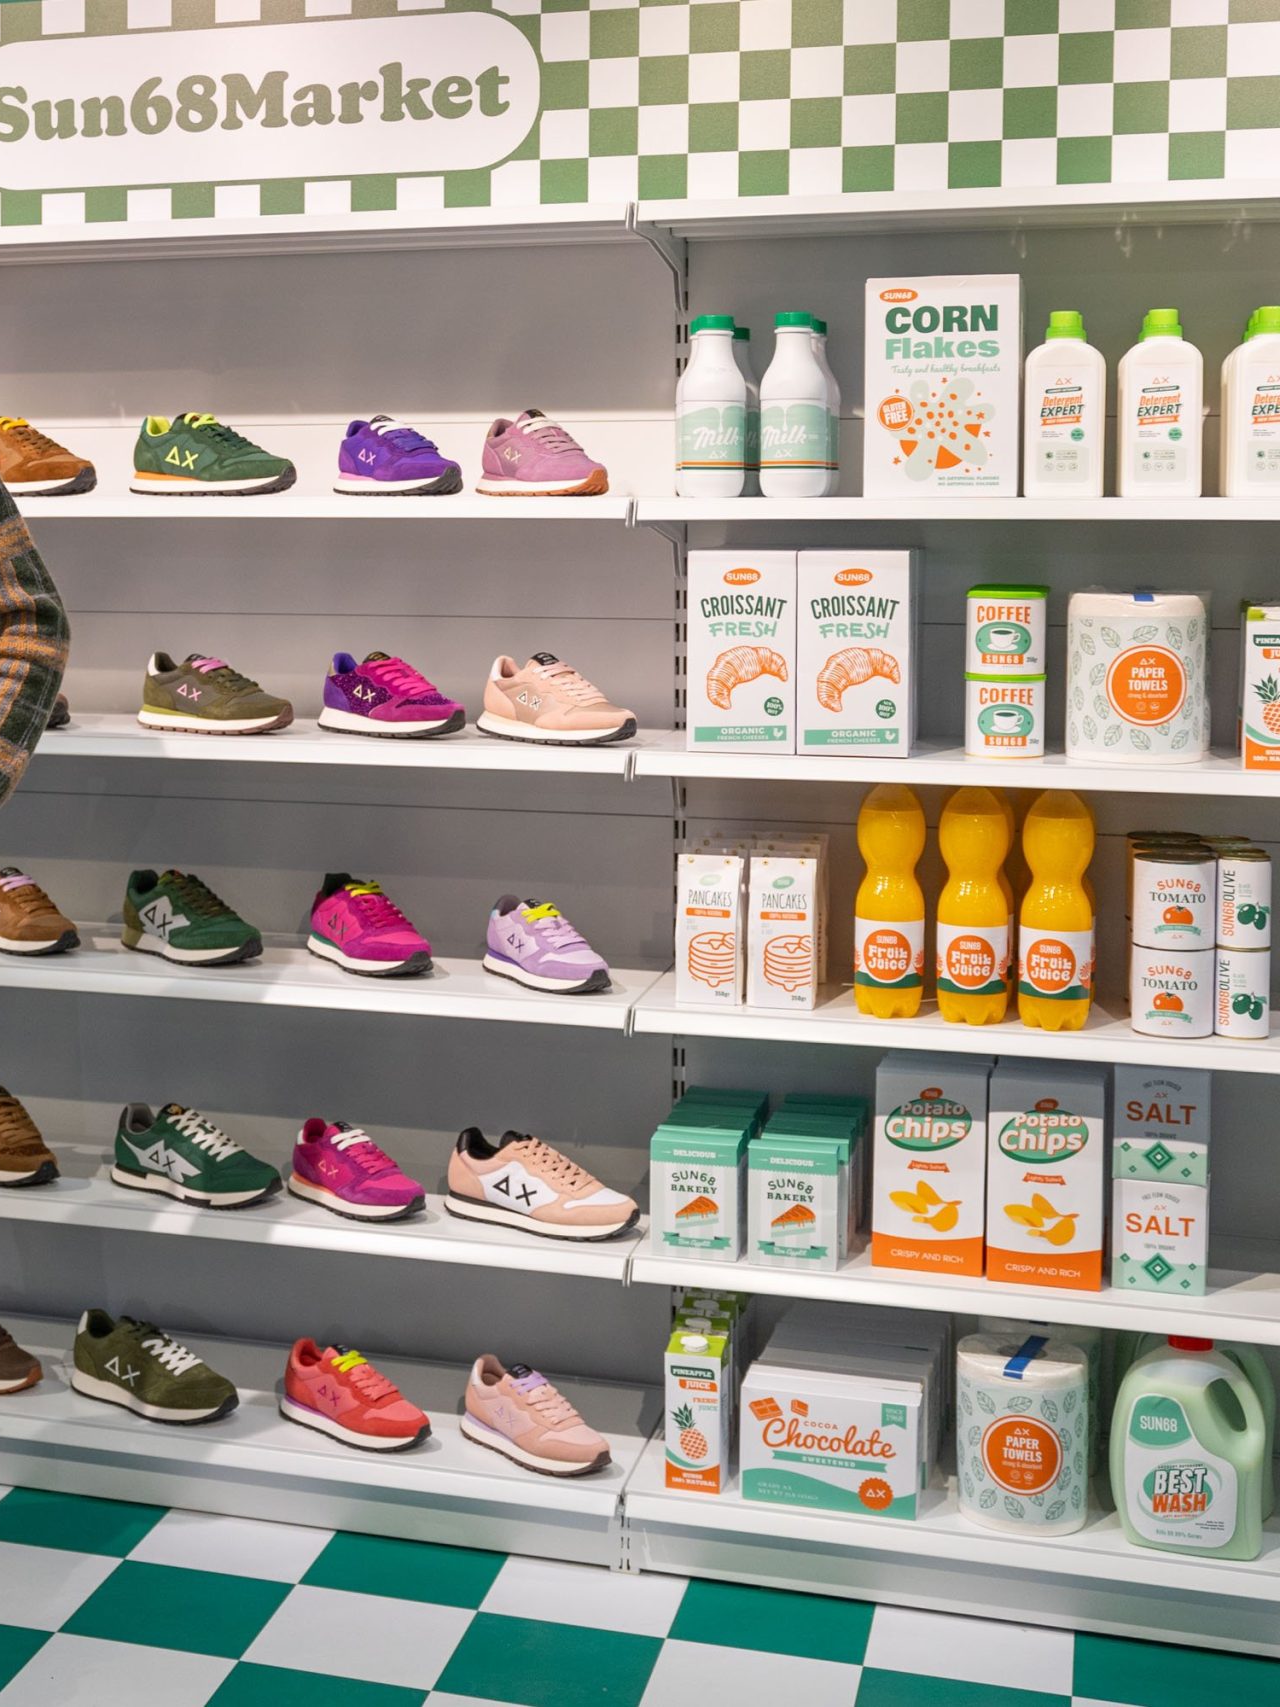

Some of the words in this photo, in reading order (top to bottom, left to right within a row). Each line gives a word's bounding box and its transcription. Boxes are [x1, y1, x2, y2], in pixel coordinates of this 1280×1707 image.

[883, 292, 912, 300] SUN68
[885, 304, 998, 334] CORN
[885, 337, 1000, 360] Flakes
[1043, 394, 1083, 407] Detergent
[1140, 393, 1181, 406] Detergent
[885, 409, 909, 425] FREE
[1041, 404, 1084, 417] EXPERT
[1137, 404, 1182, 417] EXPERT
[1252, 404, 1280, 416] EXPE
[692, 426, 739, 450] Milk
[761, 425, 807, 449] Milk
[726, 573, 758, 581] SUN68
[837, 573, 870, 582] SUN68
[700, 594, 787, 619] CROISSANT
[810, 595, 900, 620] CROISSANT
[977, 605, 1032, 625] COFFEE
[708, 620, 778, 638] FRESH
[818, 622, 890, 639] FRESH
[1255, 636, 1280, 644] PINEA
[985, 654, 1020, 664] SUN68
[1131, 667, 1165, 678] PAPER
[1128, 680, 1168, 691] TOWELS
[979, 687, 1034, 706] COFFEE
[721, 727, 765, 735] ORGANIC
[831, 730, 877, 738] ORGANIC
[989, 737, 1023, 746] SUN68
[1157, 878, 1201, 893] SUN68
[688, 889, 733, 908] PANCAKES
[761, 892, 807, 910] PANCAKES
[1149, 891, 1206, 904] TOMATO
[876, 935, 898, 945] SUN68
[959, 941, 981, 951] SUN68
[1039, 944, 1061, 954] SUN68
[1147, 965, 1192, 980] SUN68
[1141, 977, 1198, 992] TOMATO
[900, 1102, 966, 1116] Potato
[1126, 1100, 1197, 1125] SALT
[1014, 1113, 1083, 1128] Potato
[885, 1115, 967, 1143] Chips
[999, 1127, 1084, 1155] Chips
[673, 1149, 717, 1159] DELICIOUS
[770, 1157, 815, 1167] DELICIOUS
[671, 1170, 717, 1186] SUN68
[670, 1183, 717, 1195] BAKERY
[768, 1178, 814, 1195] SUN68
[767, 1192, 815, 1203] BAKERY
[1125, 1213, 1195, 1237] SALT
[890, 1248, 921, 1259] CRISPY
[922, 1252, 942, 1262] AND
[943, 1255, 964, 1264] RICH
[1005, 1263, 1036, 1273] CRISPY
[1037, 1266, 1058, 1276] AND
[1059, 1269, 1081, 1278] RICH
[673, 1368, 713, 1378] PINEAPPLE
[686, 1380, 711, 1390] JUICE
[804, 1421, 839, 1430] COCOA
[1139, 1415, 1178, 1433] SUN68
[762, 1418, 897, 1459] Chocolate
[1006, 1435, 1039, 1450] PAPER
[802, 1455, 856, 1468] SWEETENED
[1003, 1447, 1043, 1463] TOWELS
[1153, 1467, 1208, 1495] BEST
[1152, 1493, 1207, 1513] WASH
